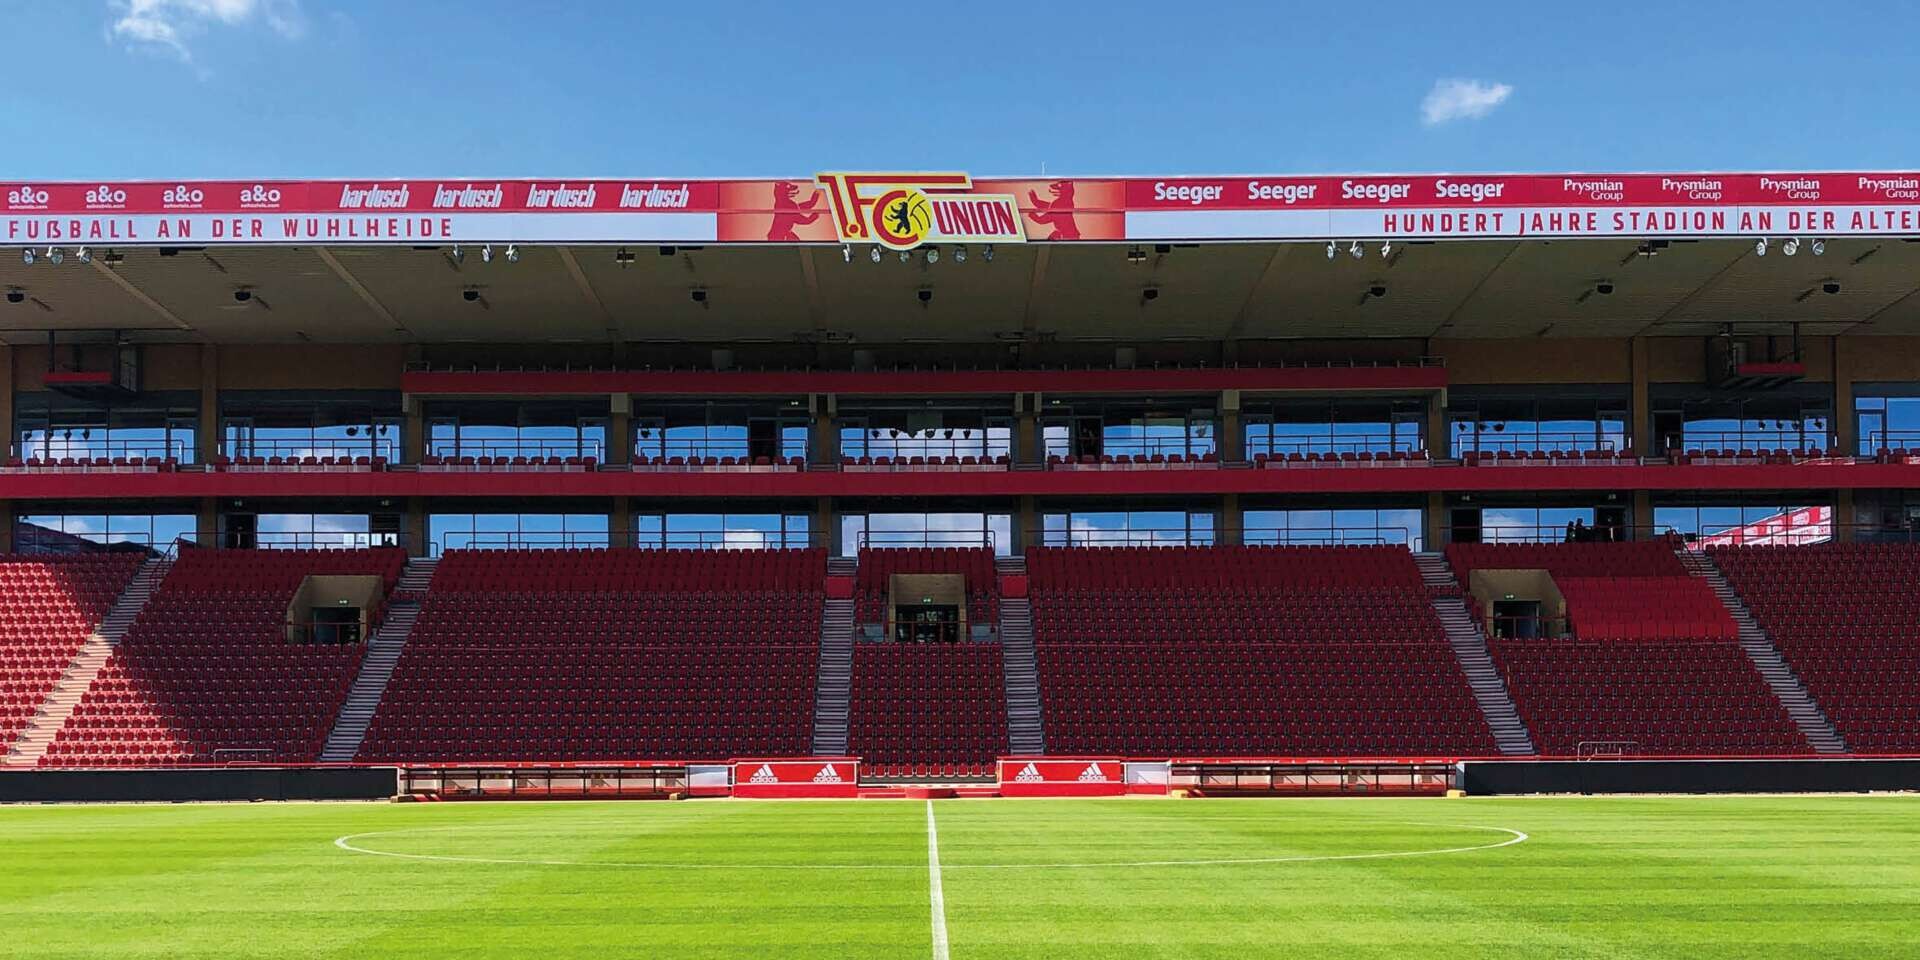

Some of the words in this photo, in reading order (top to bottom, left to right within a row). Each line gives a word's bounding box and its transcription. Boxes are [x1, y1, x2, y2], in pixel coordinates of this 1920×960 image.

[240, 184, 281, 202] a&o
[1154, 182, 1223, 204] Seeger
[1248, 181, 1317, 203] Seeger
[1342, 180, 1411, 202] Seeger
[1435, 180, 1505, 201] Seeger
[1564, 178, 1623, 195] Prysmian
[1662, 178, 1722, 194] Prysmian
[1760, 177, 1820, 194] Prysmian
[1858, 176, 1919, 193] Prysmian
[9, 186, 49, 204] a&o
[86, 185, 126, 203] a&o
[163, 185, 204, 203] a&o
[1591, 191, 1623, 201] Group
[1689, 190, 1722, 201] Group
[1787, 190, 1820, 200] Group
[1886, 189, 1919, 200] Group
[932, 200, 1017, 235] UNION
[1384, 213, 1503, 232] HUNDERT
[1519, 212, 1597, 235] JAHRE
[1613, 211, 1724, 231] STADION
[1740, 211, 1771, 230] AN
[1788, 211, 1835, 230] DER
[1850, 211, 1920, 230] ALTE
[157, 219, 191, 238] AN
[212, 219, 263, 238] DER
[283, 218, 451, 237] WUHLHEIDE
[749, 775, 779, 783] adidas
[813, 775, 842, 783] adidas
[1015, 774, 1044, 782] adidas
[1078, 774, 1107, 782] adidas
